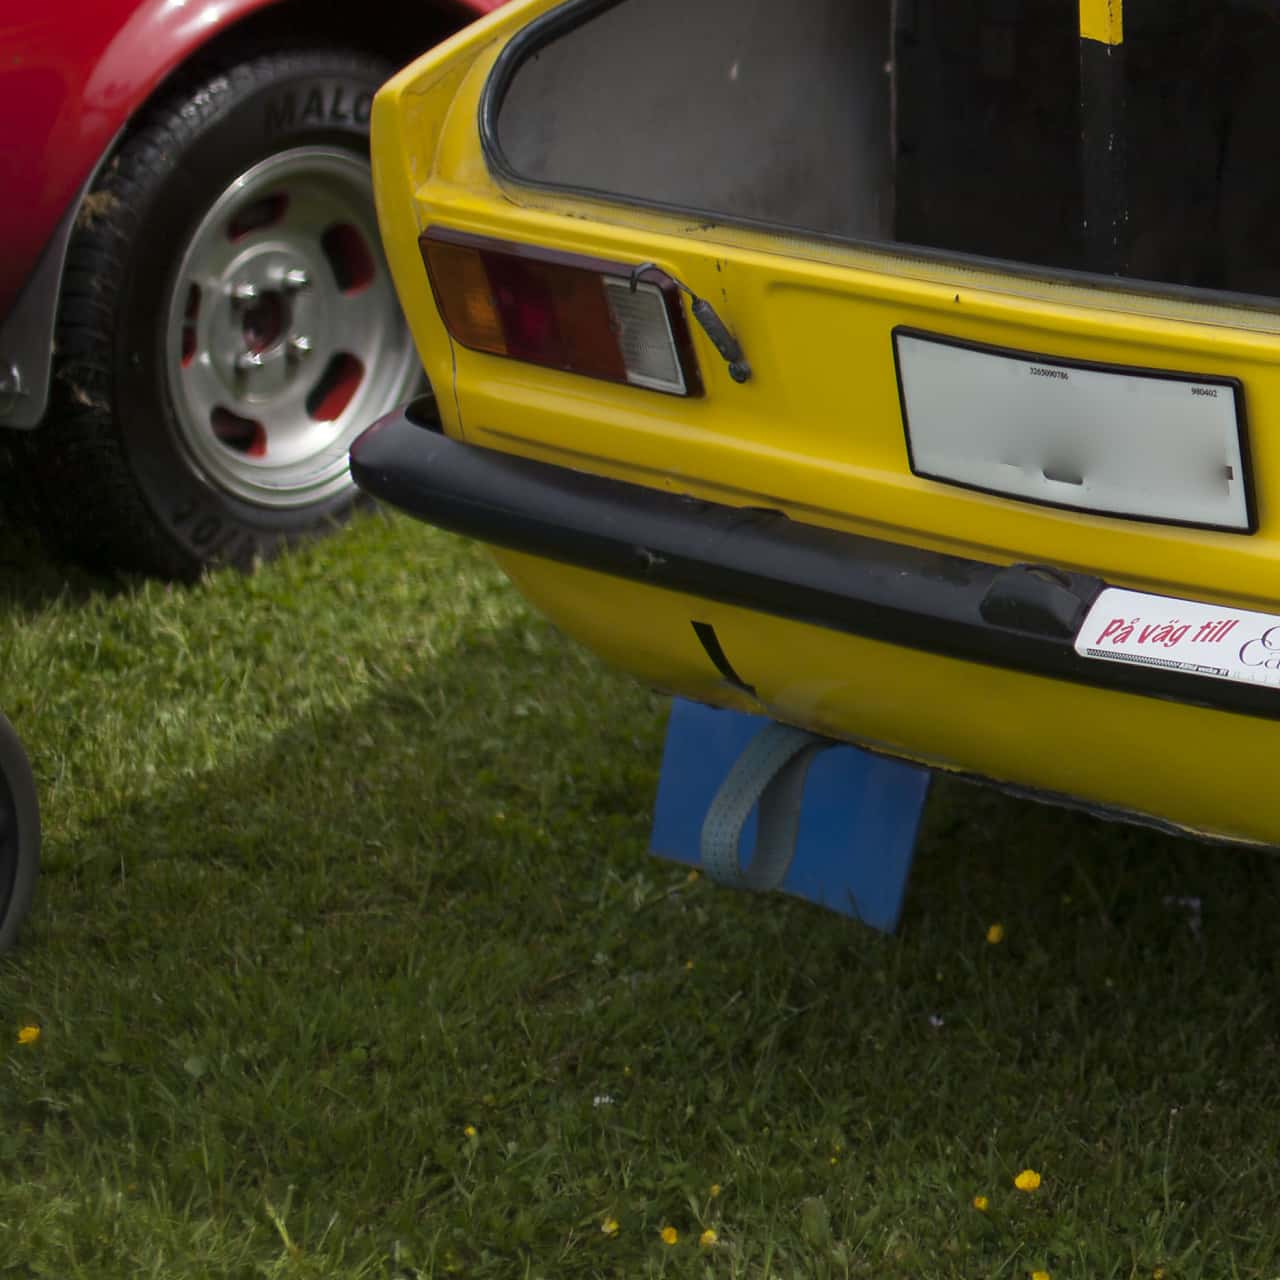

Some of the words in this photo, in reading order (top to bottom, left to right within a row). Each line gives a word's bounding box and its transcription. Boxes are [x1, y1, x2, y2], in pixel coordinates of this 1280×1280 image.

[1097, 617, 1138, 645] På
[1140, 617, 1190, 648] väg
[1192, 619, 1240, 644] till
